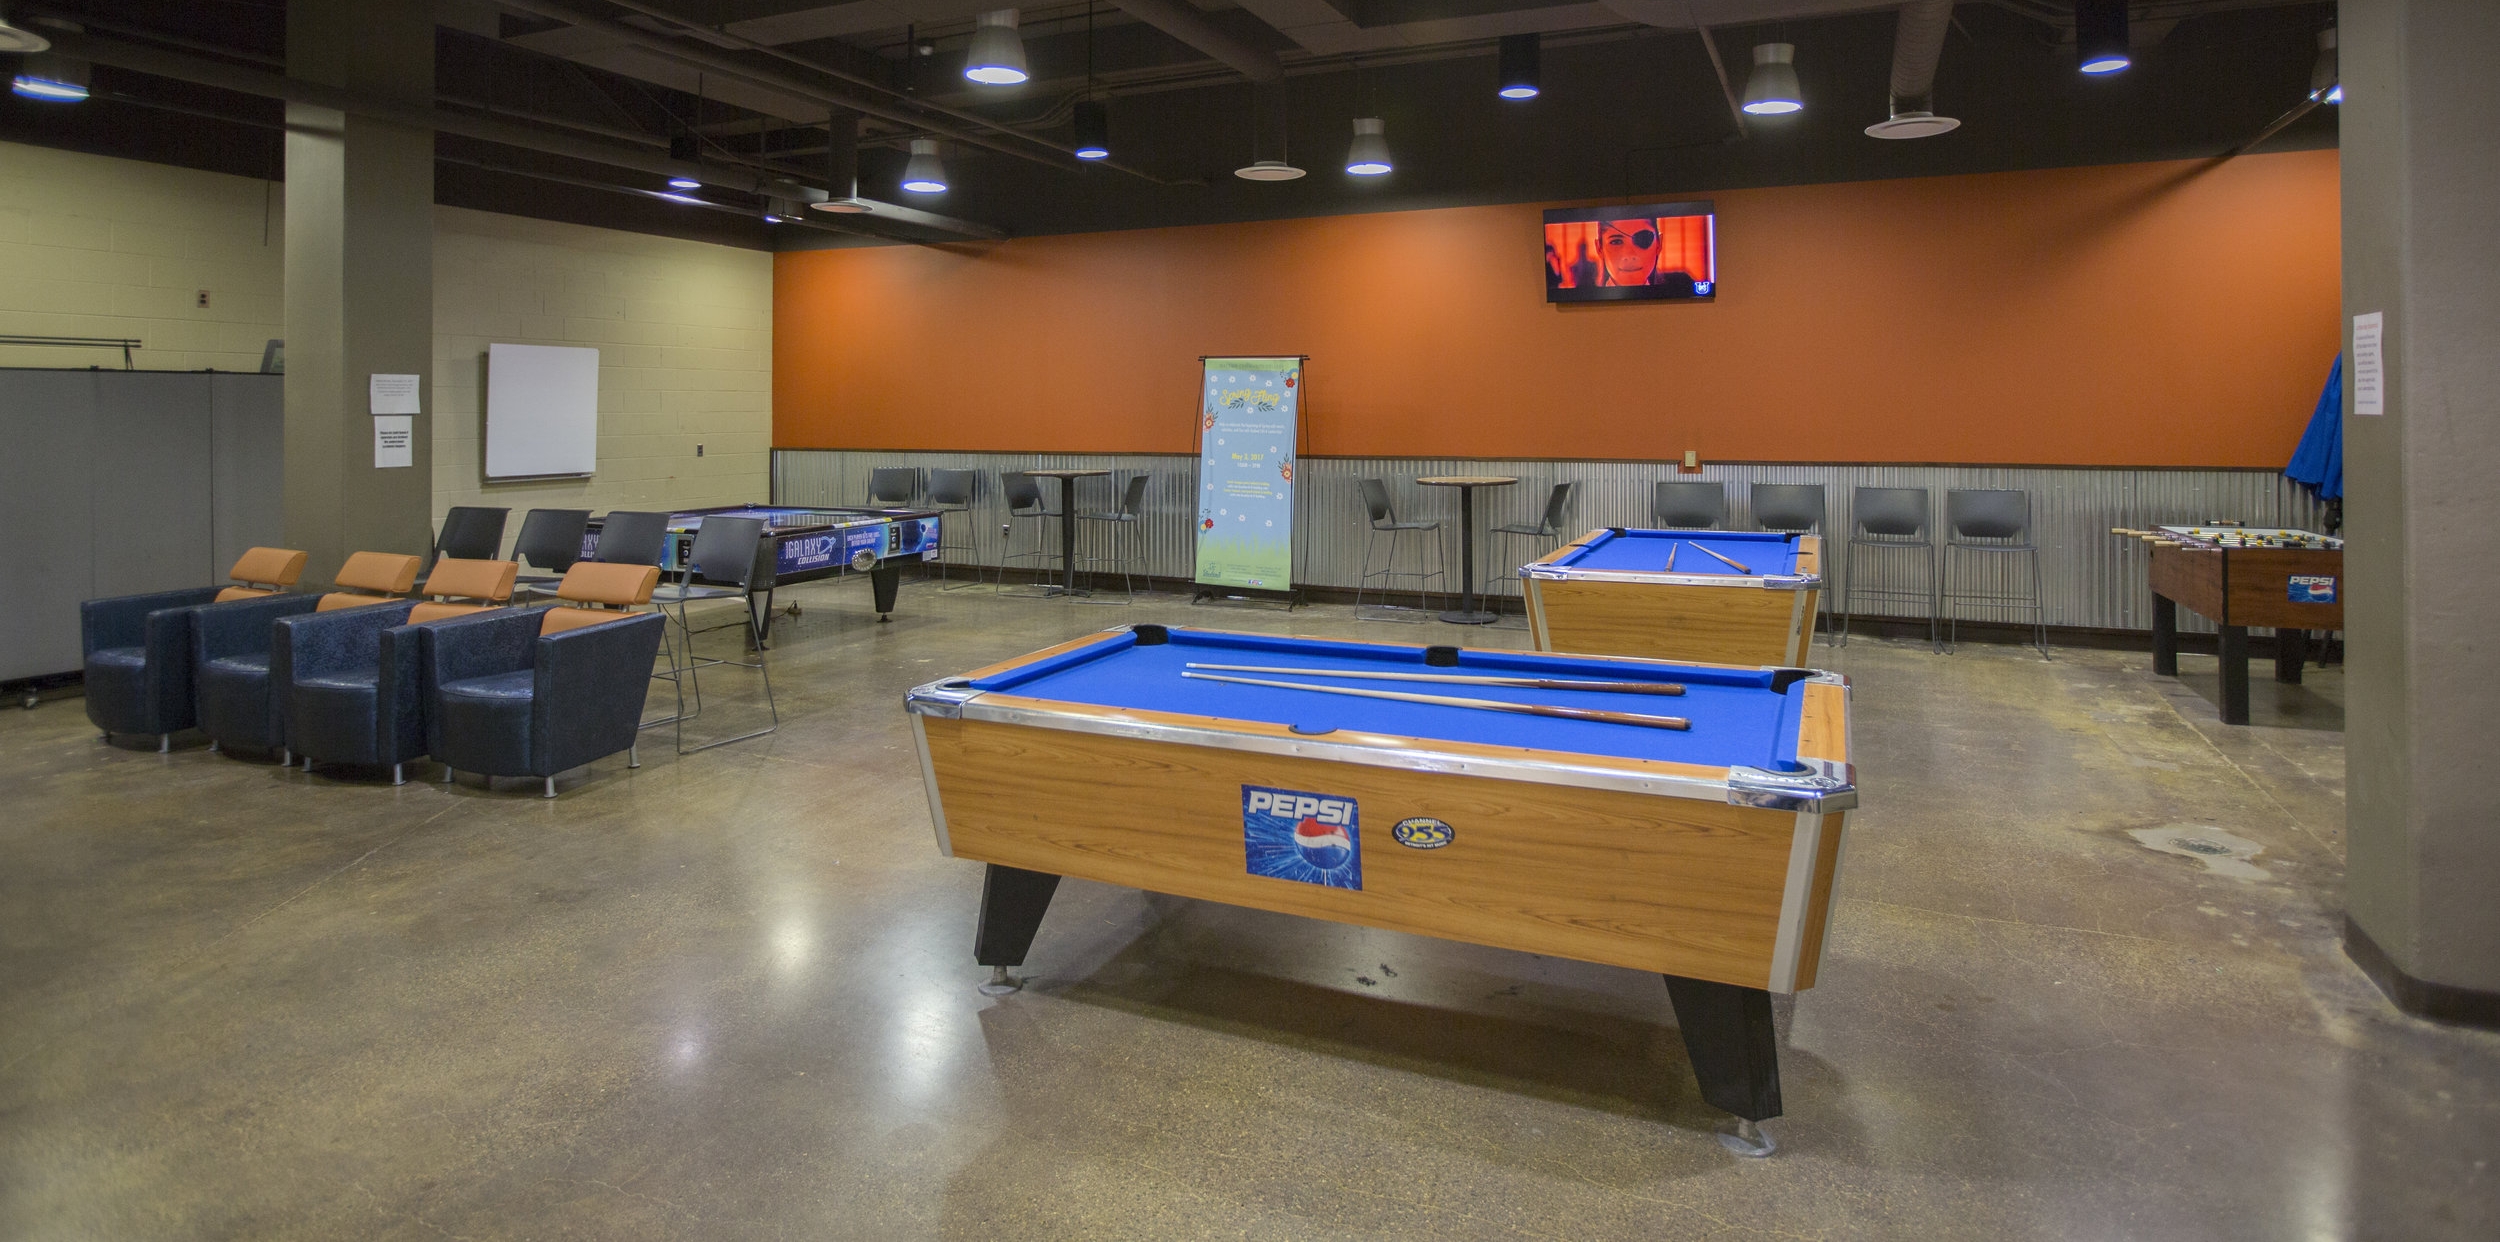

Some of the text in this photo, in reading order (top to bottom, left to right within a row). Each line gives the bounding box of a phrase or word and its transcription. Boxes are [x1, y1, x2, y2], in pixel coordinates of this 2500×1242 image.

[1219, 388, 1280, 407] Spring Fling
[797, 553, 830, 565] COLLISION
[2289, 576, 2334, 586] PEPSI
[1248, 790, 1354, 826] PEPSI
[1402, 818, 1441, 826] CHANNEL
